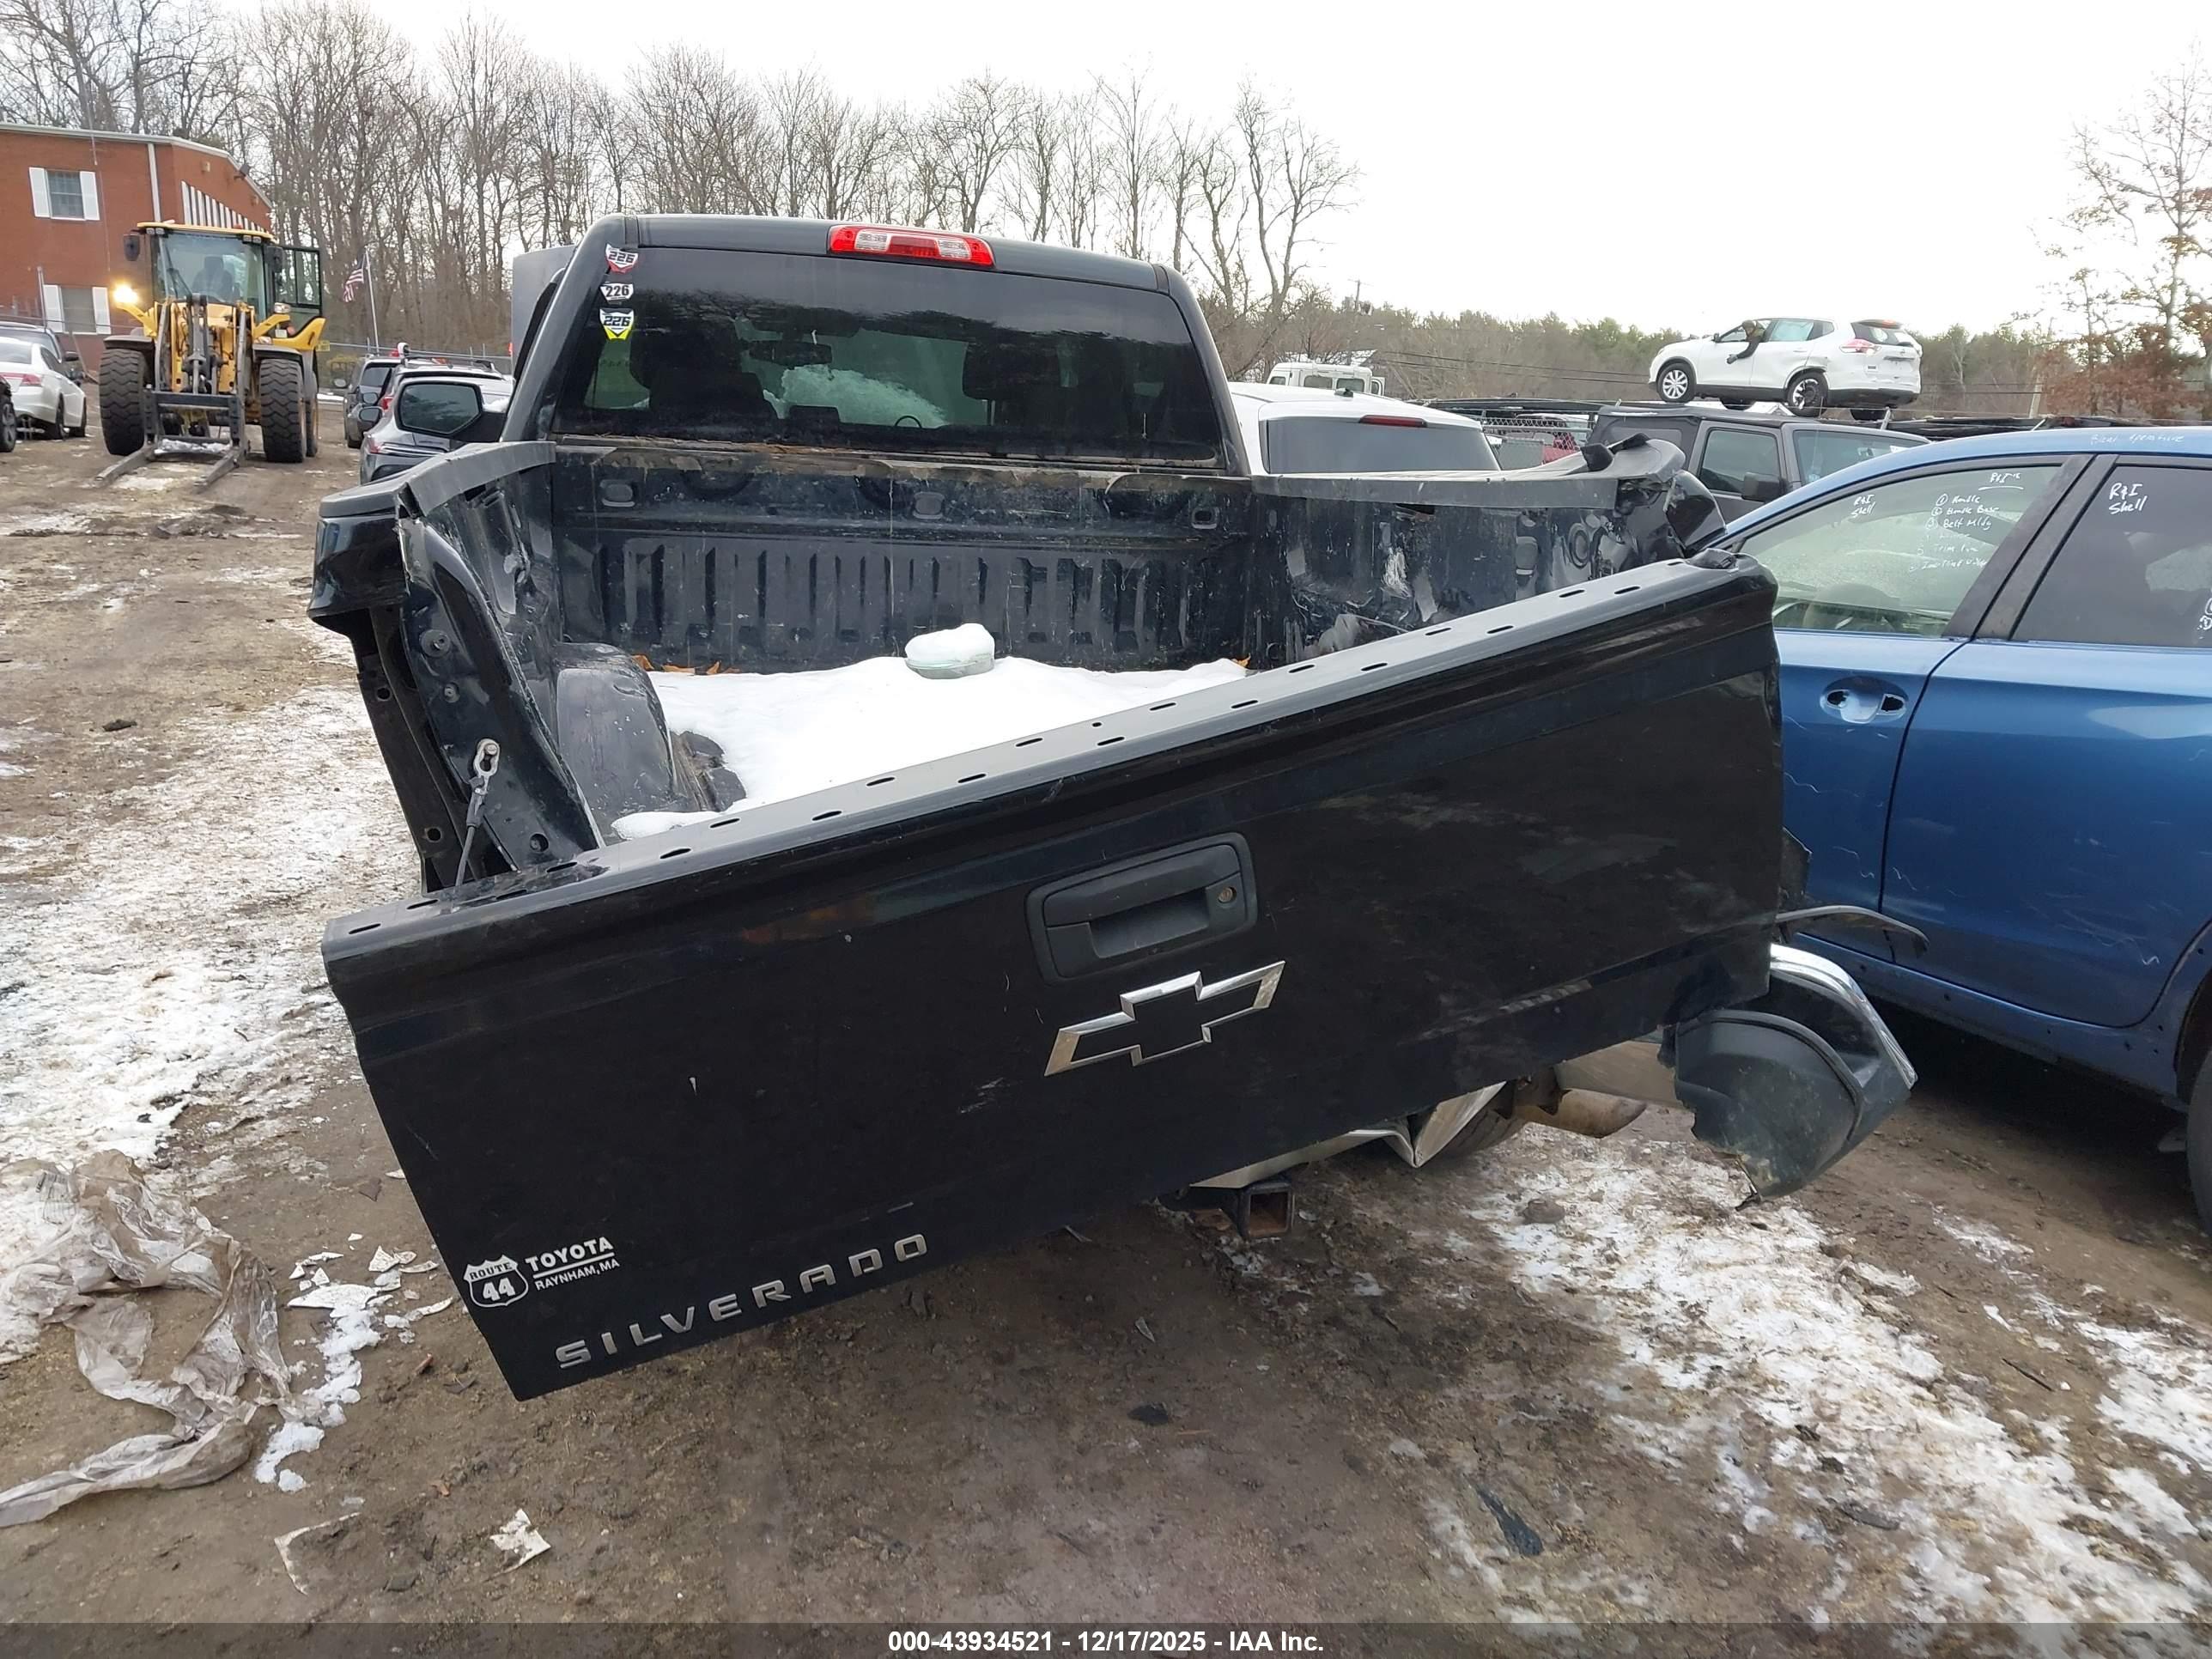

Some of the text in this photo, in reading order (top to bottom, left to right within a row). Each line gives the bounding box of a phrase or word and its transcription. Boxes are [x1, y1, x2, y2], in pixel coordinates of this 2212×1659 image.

[608, 251, 635, 264] 226
[605, 285, 629, 297] 226
[604, 316, 631, 326] 226
[2108, 495, 2148, 515] Shell
[525, 1236, 615, 1273] TOYOTA
[469, 1261, 514, 1281] ROUTE
[482, 1276, 516, 1302] 44
[555, 1233, 928, 1369] SILVERADO
